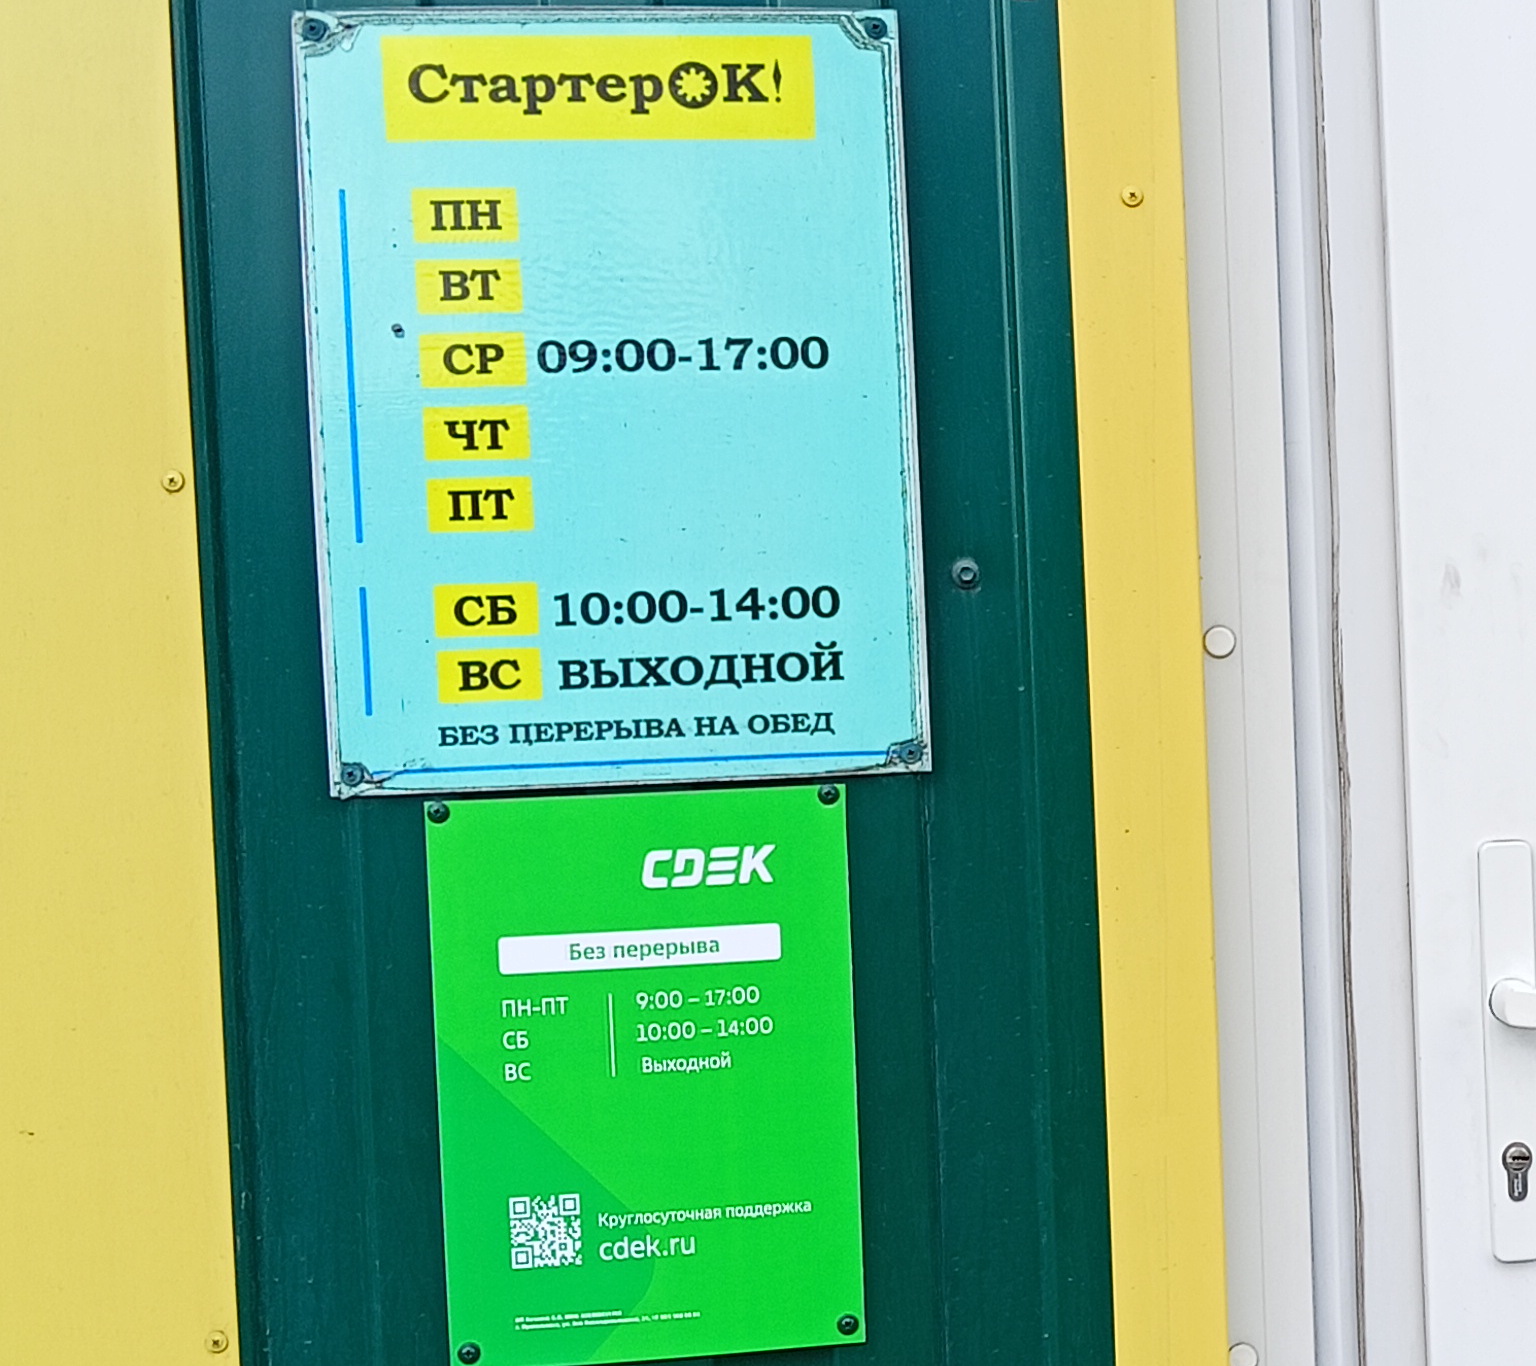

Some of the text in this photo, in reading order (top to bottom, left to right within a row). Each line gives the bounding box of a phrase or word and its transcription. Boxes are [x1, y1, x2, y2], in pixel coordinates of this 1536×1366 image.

[430, 199, 502, 231] ПН
[438, 269, 501, 301] ВТ
[443, 336, 829, 375] СР 09:00-17:00
[443, 418, 510, 451] ЧТ
[447, 488, 515, 521] ПТ
[453, 585, 841, 627] СБ 10:00-14:00
[457, 640, 845, 692] ВС ВЫХОДНОЙ
[438, 724, 500, 747] БЕЗ
[693, 715, 740, 737] НА
[747, 712, 836, 736] ОБЕД
[641, 844, 776, 889] CDEK
[569, 938, 721, 961] Без перерыва
[502, 996, 569, 1018] ПН-ПТ
[636, 990, 683, 1010] 9:00
[705, 986, 760, 1006] 17:00
[502, 1030, 529, 1050] СБ
[637, 1021, 696, 1042] 10:00
[717, 1016, 773, 1037] 14:00
[504, 1051, 732, 1081] ВС Выходной
[598, 1201, 812, 1229] Круглосуточная поддержка
[599, 1234, 695, 1261] cdek.ru
